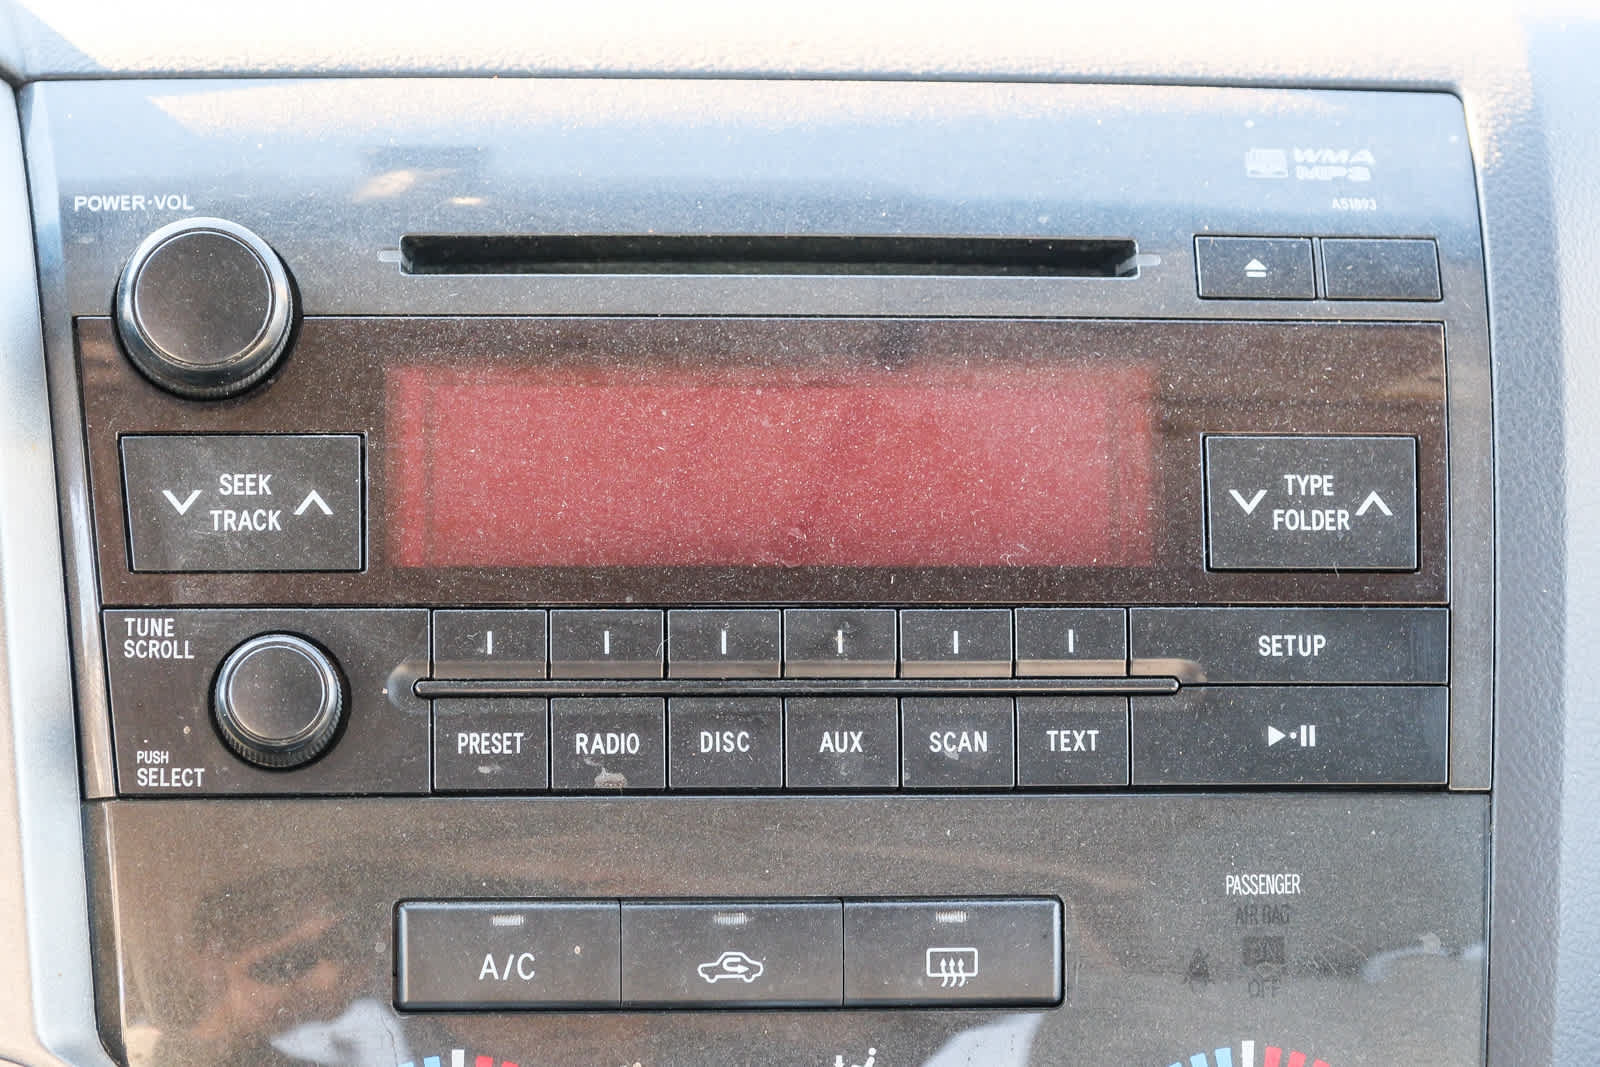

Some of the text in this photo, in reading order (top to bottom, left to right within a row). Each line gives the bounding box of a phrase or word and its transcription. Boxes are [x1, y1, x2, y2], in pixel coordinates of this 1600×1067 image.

[218, 473, 272, 496] SEEK
[1284, 474, 1335, 497] TYPE
[209, 508, 282, 532] TRACK
[1271, 508, 1351, 532] FOLDER
[124, 617, 175, 638] TUNE
[123, 639, 196, 660] SCROLL
[1257, 634, 1327, 658] SETUP
[456, 732, 525, 755] PRESET
[574, 732, 641, 755] RADIO
[699, 731, 751, 753] DISC
[818, 730, 864, 753] AUX
[928, 730, 989, 753] SCAN
[1045, 729, 1099, 752] TEXT
[136, 750, 169, 765] PUSH
[136, 767, 206, 788] SELECT
[1224, 873, 1302, 896] PASSENGER
[477, 952, 537, 981] A/C
